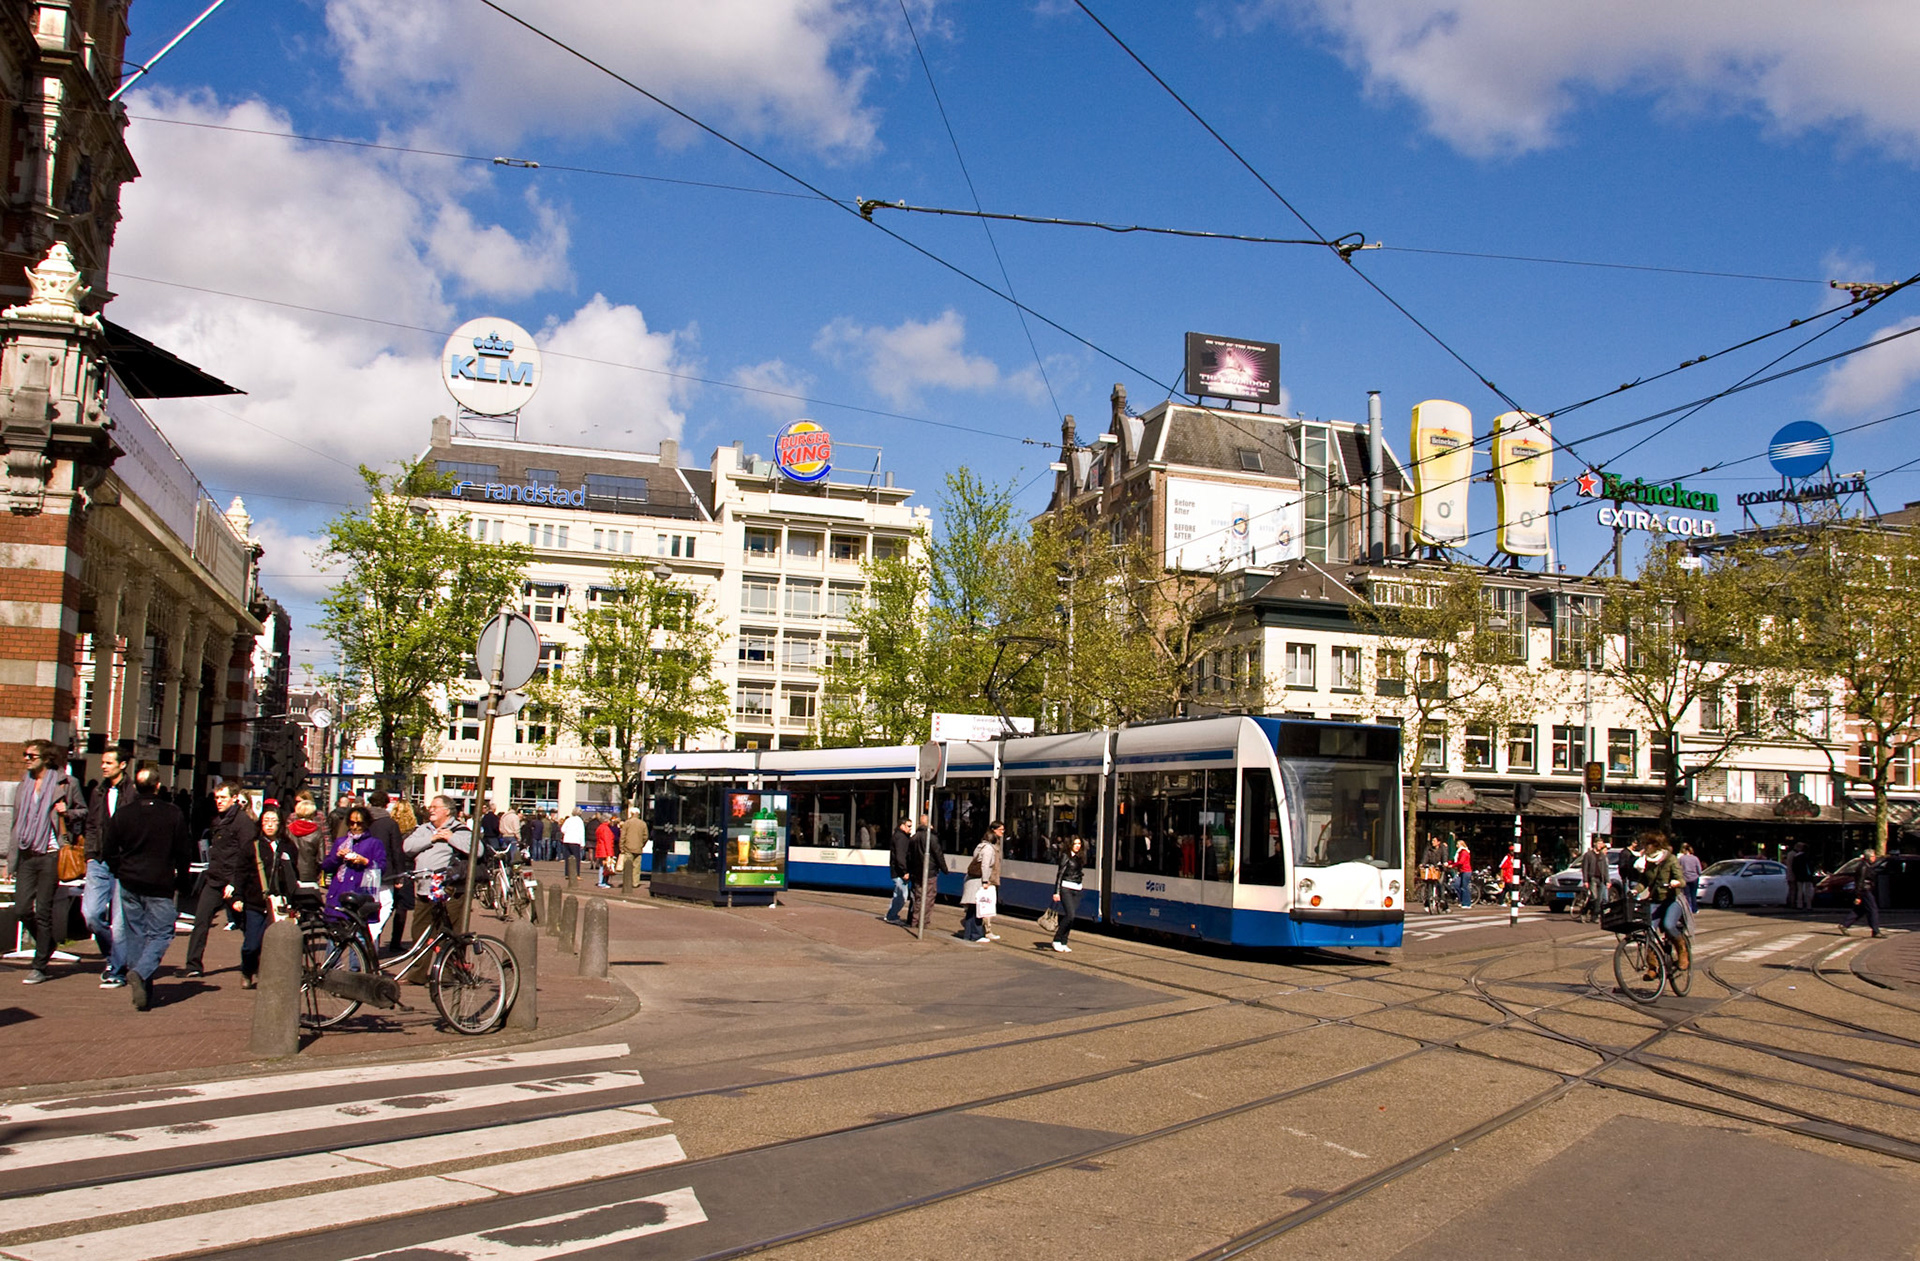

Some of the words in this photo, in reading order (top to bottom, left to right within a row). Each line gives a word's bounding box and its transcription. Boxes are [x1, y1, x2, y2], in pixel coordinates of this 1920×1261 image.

[451, 354, 534, 387] KLM
[780, 432, 830, 450] BURGER
[781, 444, 831, 466] KING
[485, 480, 586, 507] randstad
[1601, 472, 1720, 512] Heineken
[1737, 488, 1794, 505] KONICA
[1798, 480, 1870, 499] MINOLTA
[1174, 499, 1196, 508] Before
[1174, 507, 1190, 515] After
[1174, 523, 1196, 533] BEFORE
[1597, 507, 1664, 532] EXTRA
[1666, 515, 1716, 538] COLD
[1174, 532, 1192, 541] AFTER
